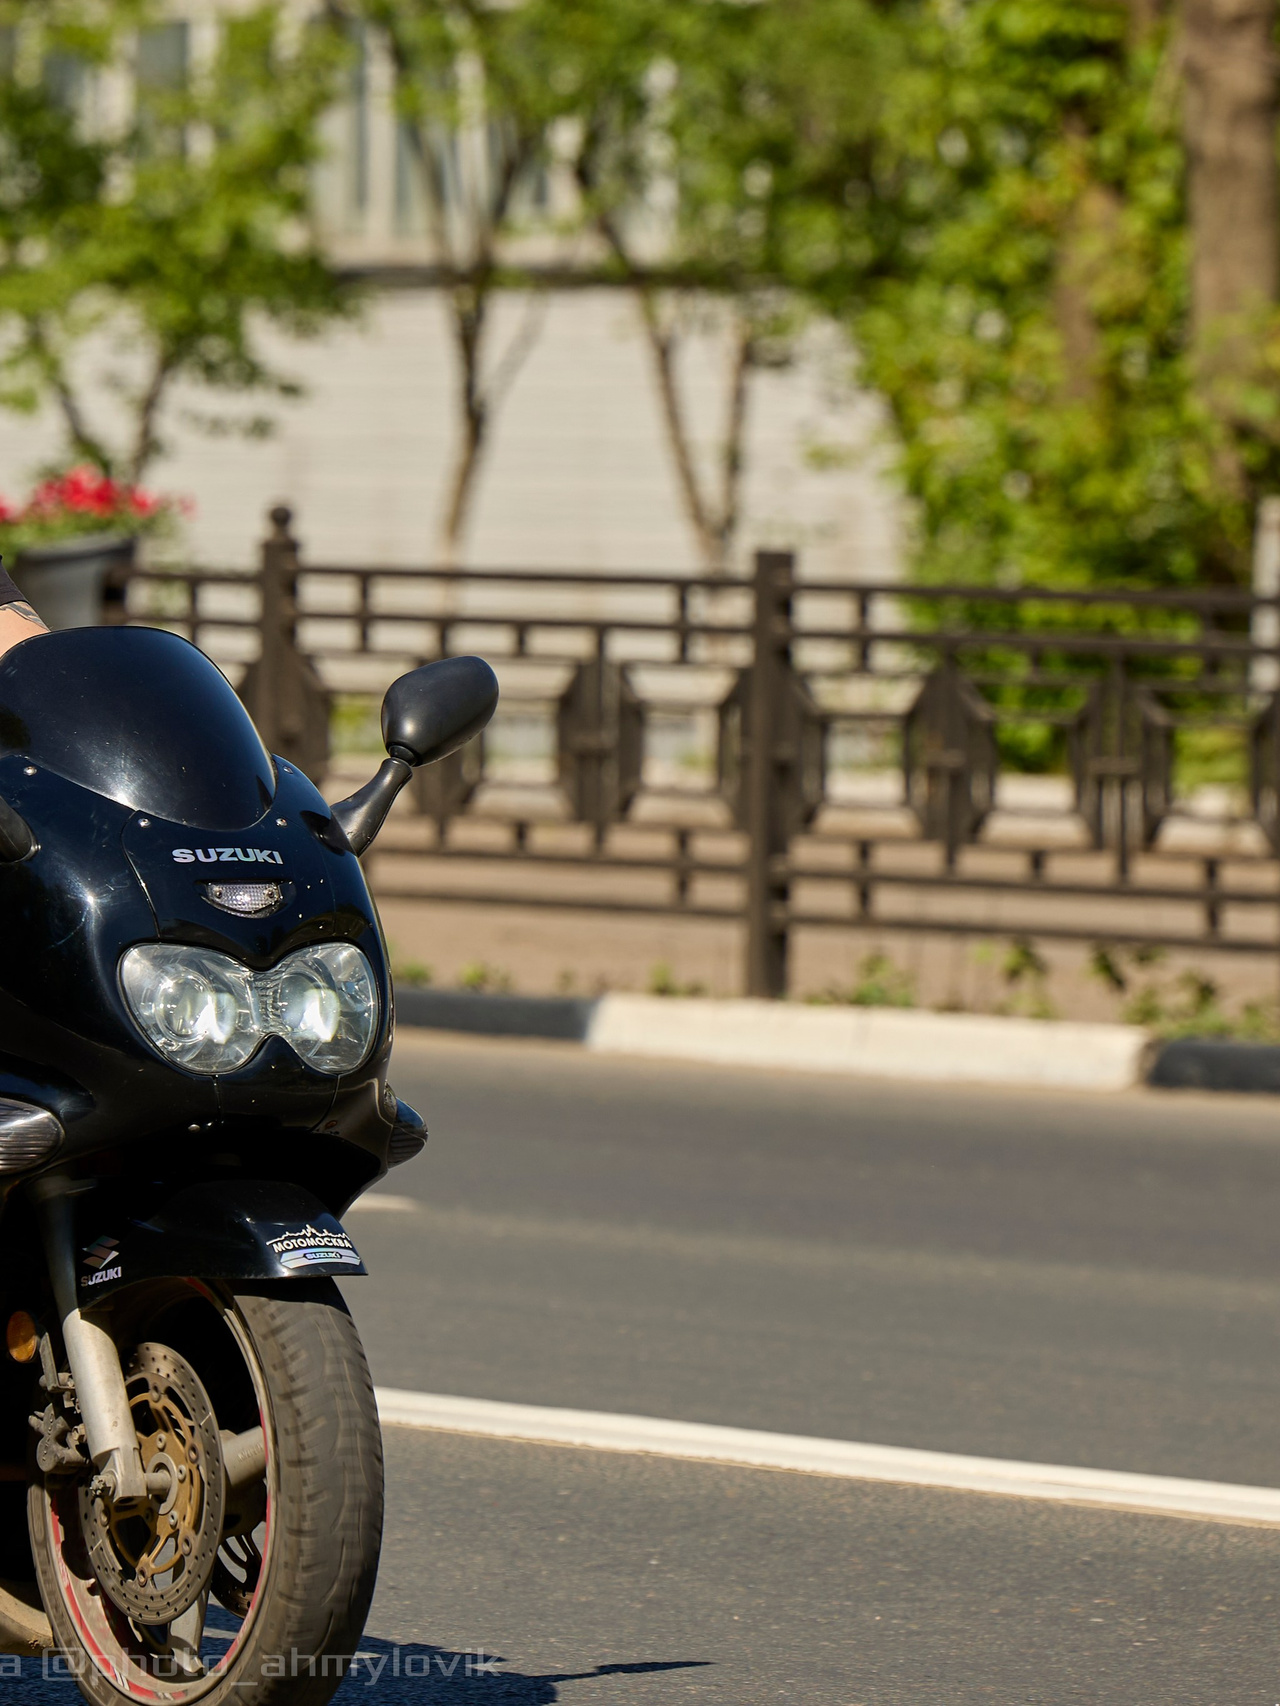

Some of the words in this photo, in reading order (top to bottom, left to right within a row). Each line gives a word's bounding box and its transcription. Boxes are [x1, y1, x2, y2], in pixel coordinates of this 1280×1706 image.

[172, 847, 284, 865] SUZUKI
[272, 1236, 353, 1253] МОТОМОСКВА
[305, 1251, 341, 1260] SUZUKI
[80, 1266, 122, 1288] SUZUKI
